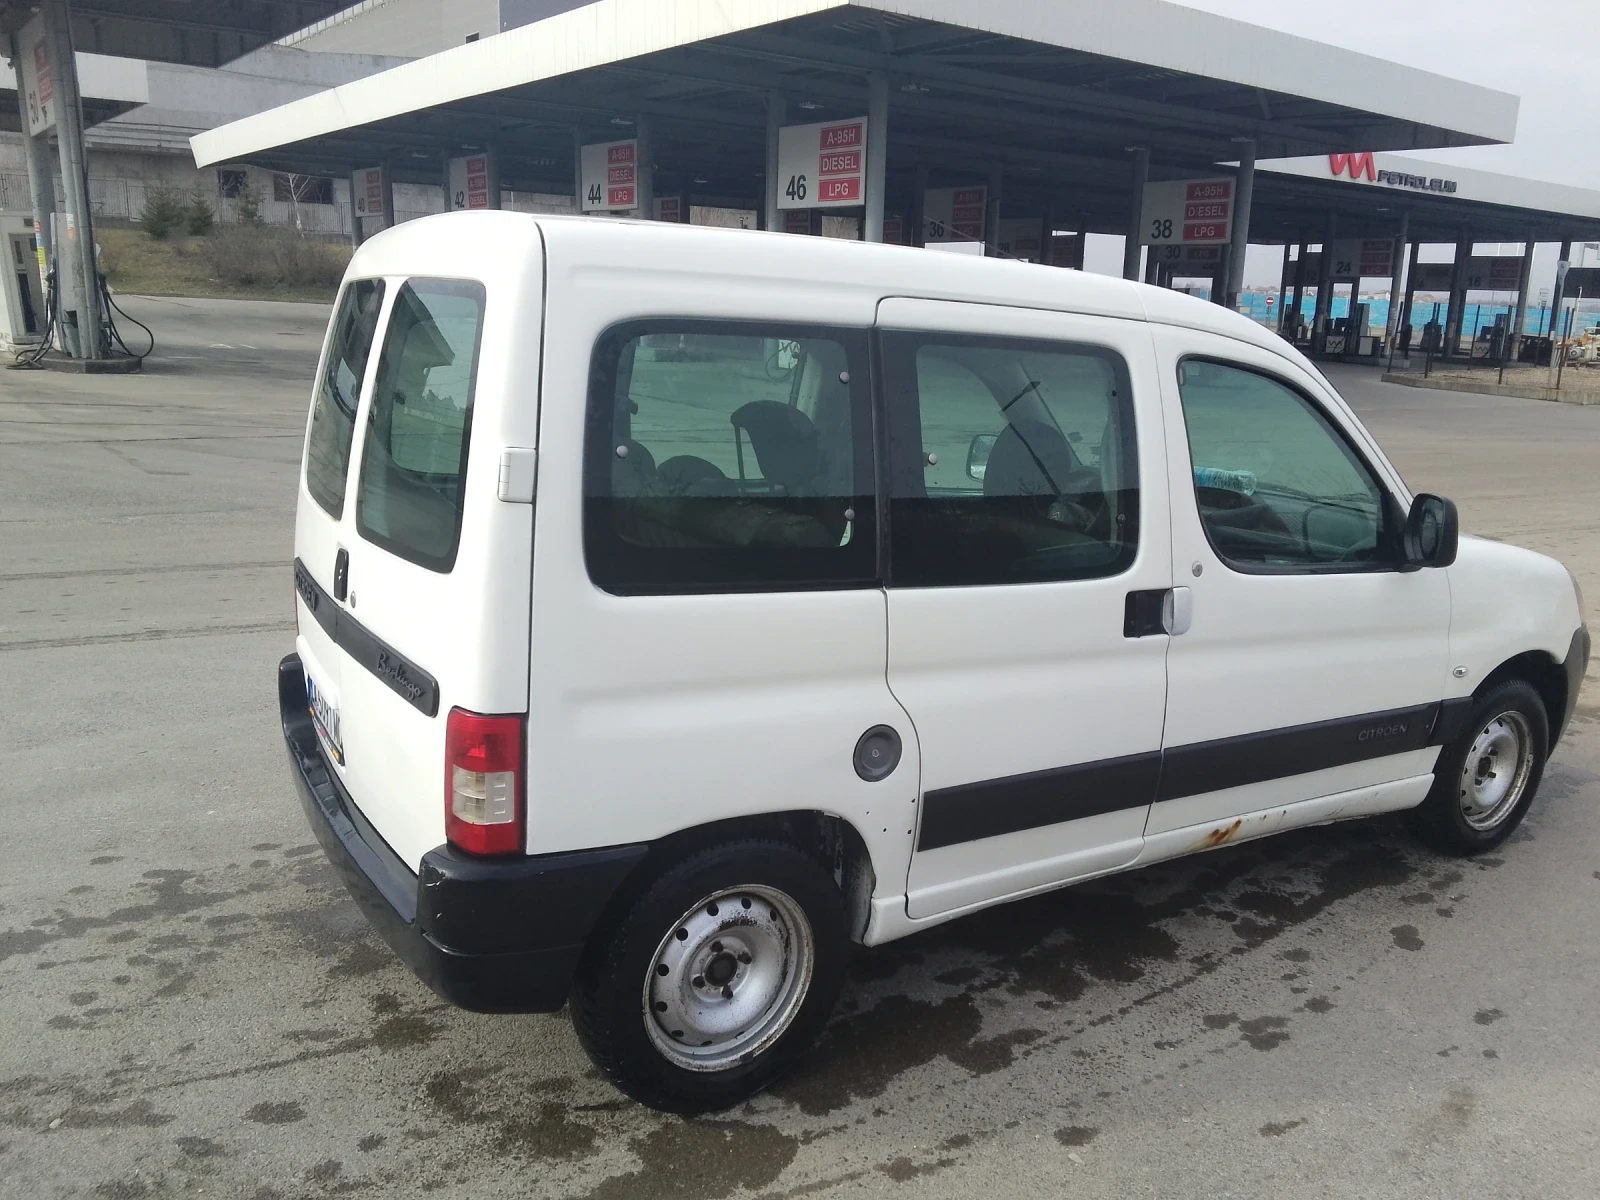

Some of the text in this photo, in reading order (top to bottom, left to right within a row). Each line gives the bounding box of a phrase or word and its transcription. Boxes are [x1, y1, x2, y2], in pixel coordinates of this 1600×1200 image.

[827, 129, 855, 145] A-95H
[822, 156, 857, 171] DIESEL
[609, 169, 632, 181] DIESEL
[1377, 169, 1457, 193] PETROLEUM
[588, 183, 602, 204] 44
[785, 174, 807, 200] 46
[828, 183, 849, 197] LPG
[1194, 186, 1224, 197] A-95H
[455, 191, 465, 208] 42
[470, 196, 485, 206] DIESEL
[614, 190, 628, 202] LPG
[1188, 206, 1224, 217] DIESEL
[929, 220, 944, 238] 36
[1151, 219, 1172, 239] 38
[1194, 226, 1215, 237] LPG
[1164, 244, 1181, 259] 30
[1335, 261, 1351, 274] 24
[376, 650, 422, 701] Berlingo
